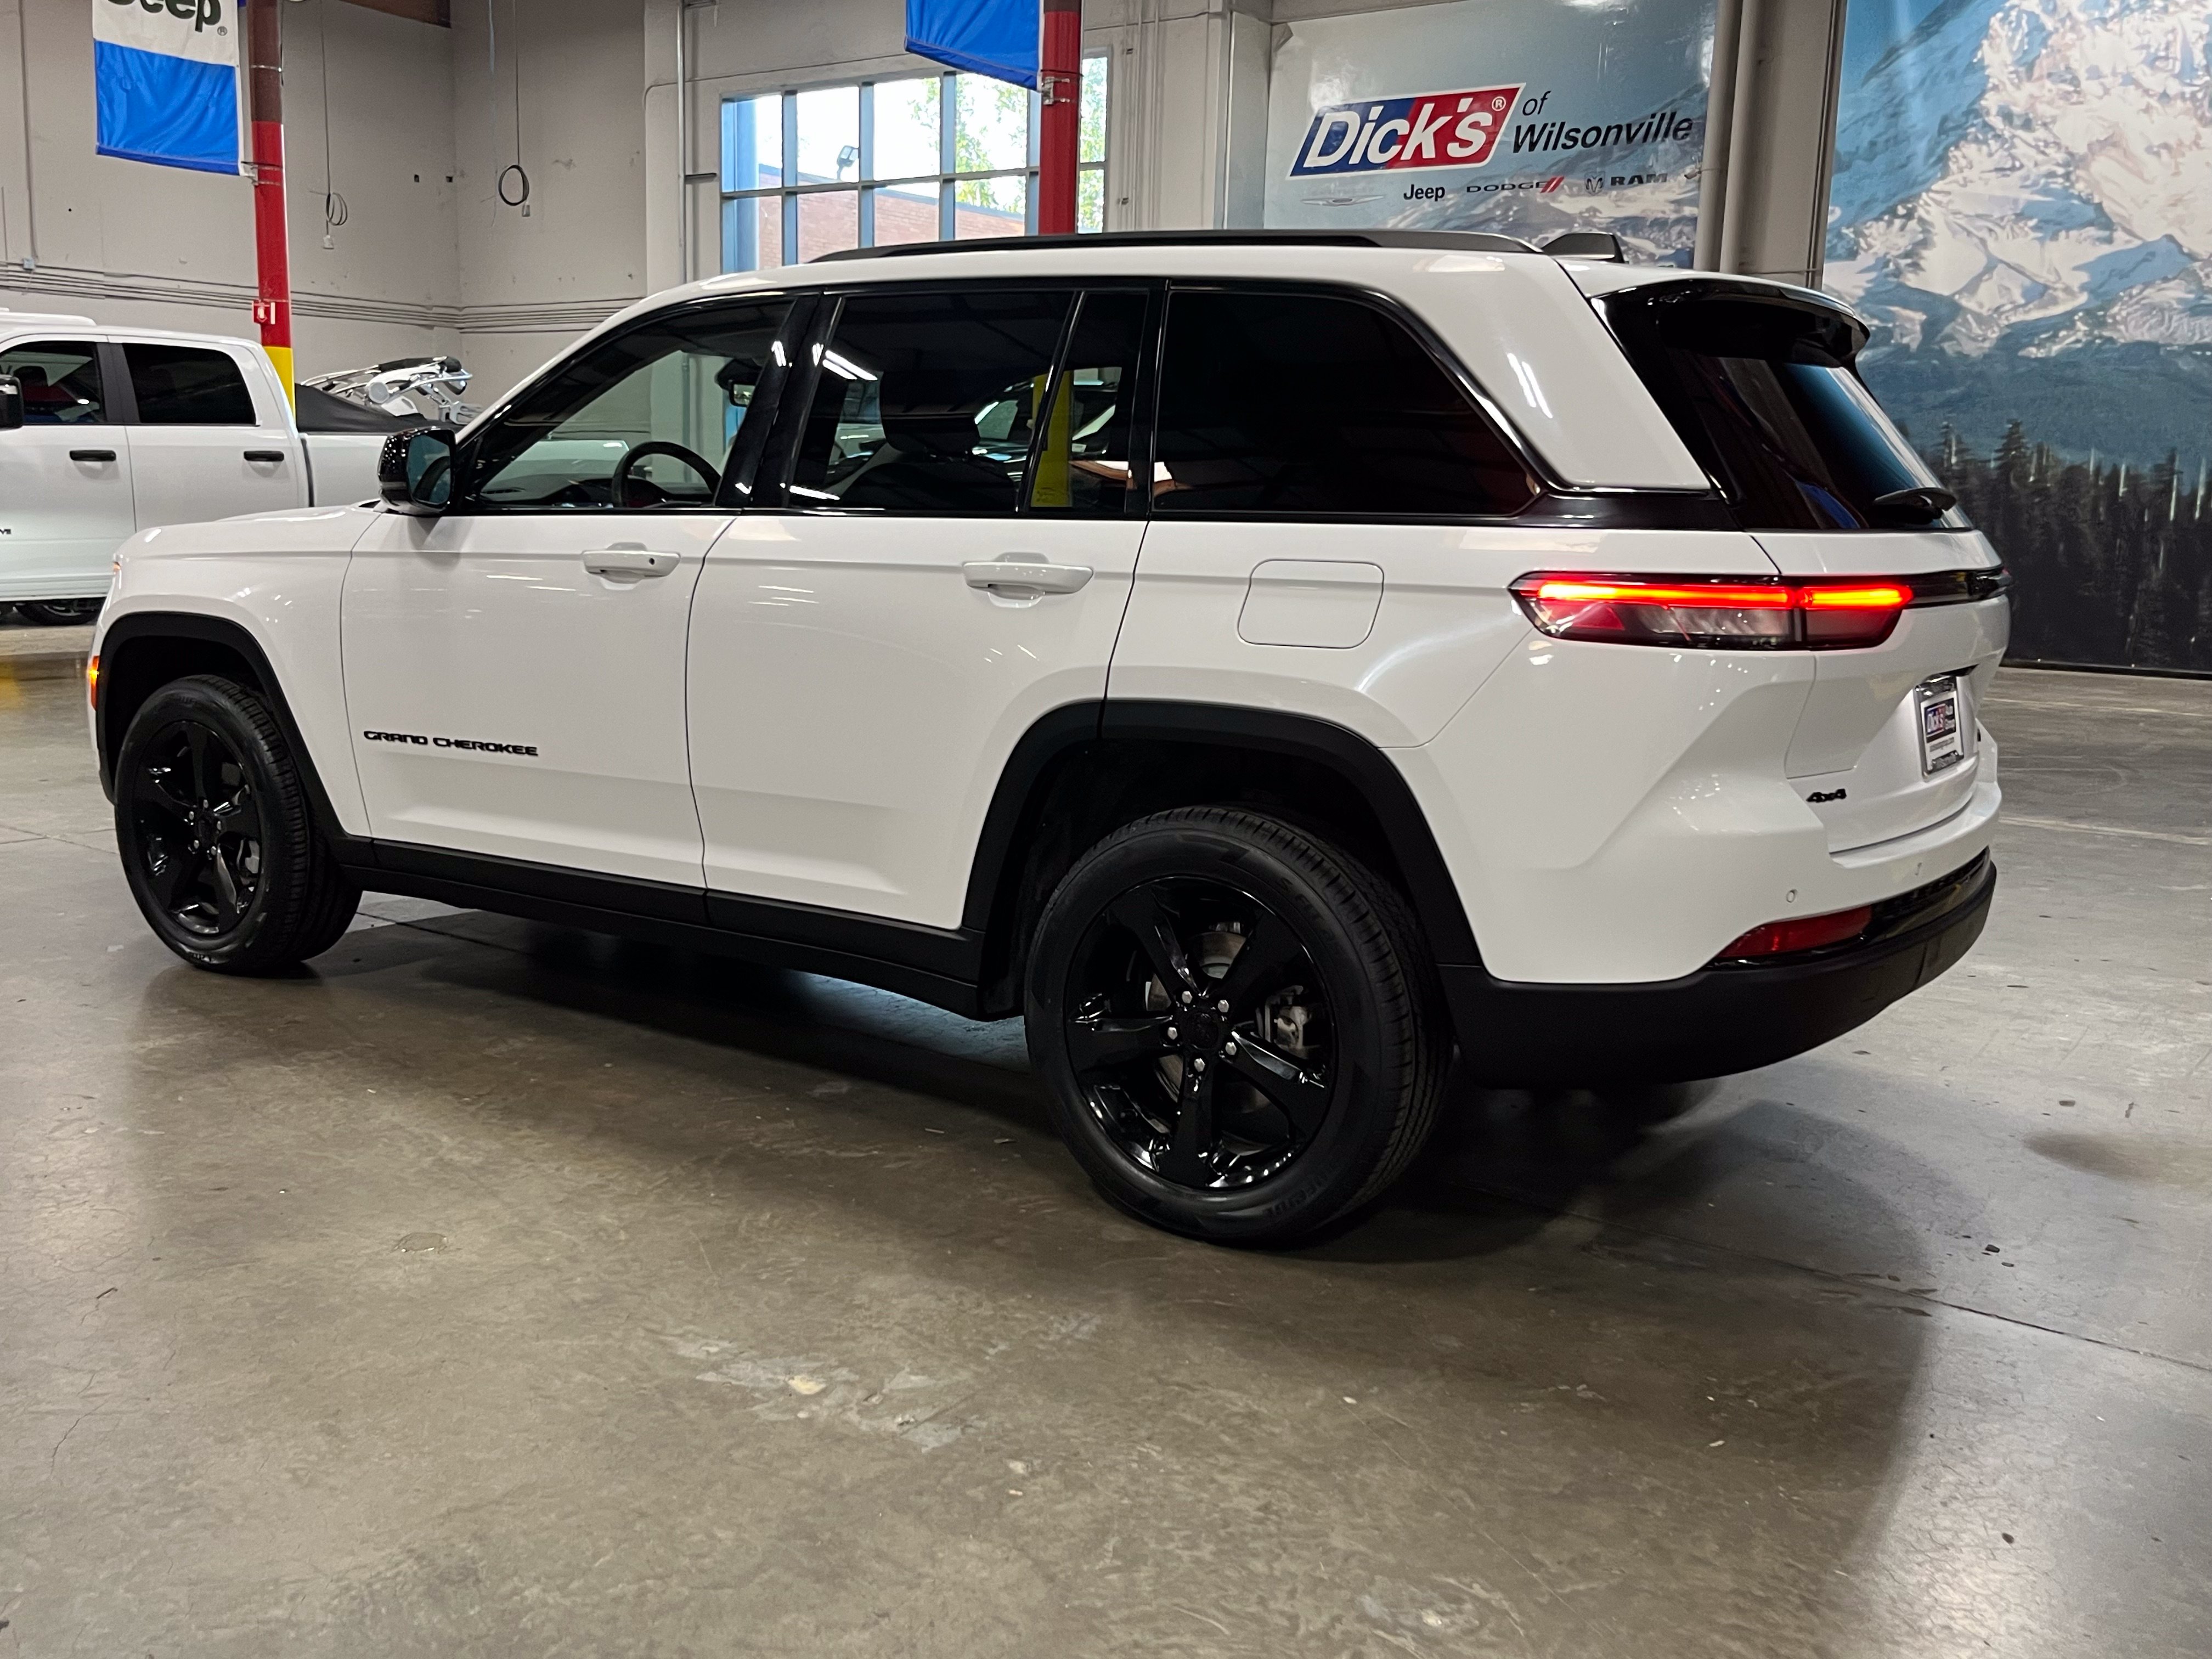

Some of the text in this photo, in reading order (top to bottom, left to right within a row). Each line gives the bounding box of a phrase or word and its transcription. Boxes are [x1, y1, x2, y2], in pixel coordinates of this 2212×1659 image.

[108, 0, 222, 32] ep
[1522, 91, 1551, 116] of
[1303, 97, 1493, 168] Dick's
[1513, 111, 1693, 153] Wilsonville
[1466, 180, 1549, 193] DODGE
[1610, 173, 1668, 186] RAM
[1403, 184, 1446, 202] Jeep
[364, 731, 539, 757] GRAND CHEROKEE
[1805, 788, 1847, 803] 4x4
